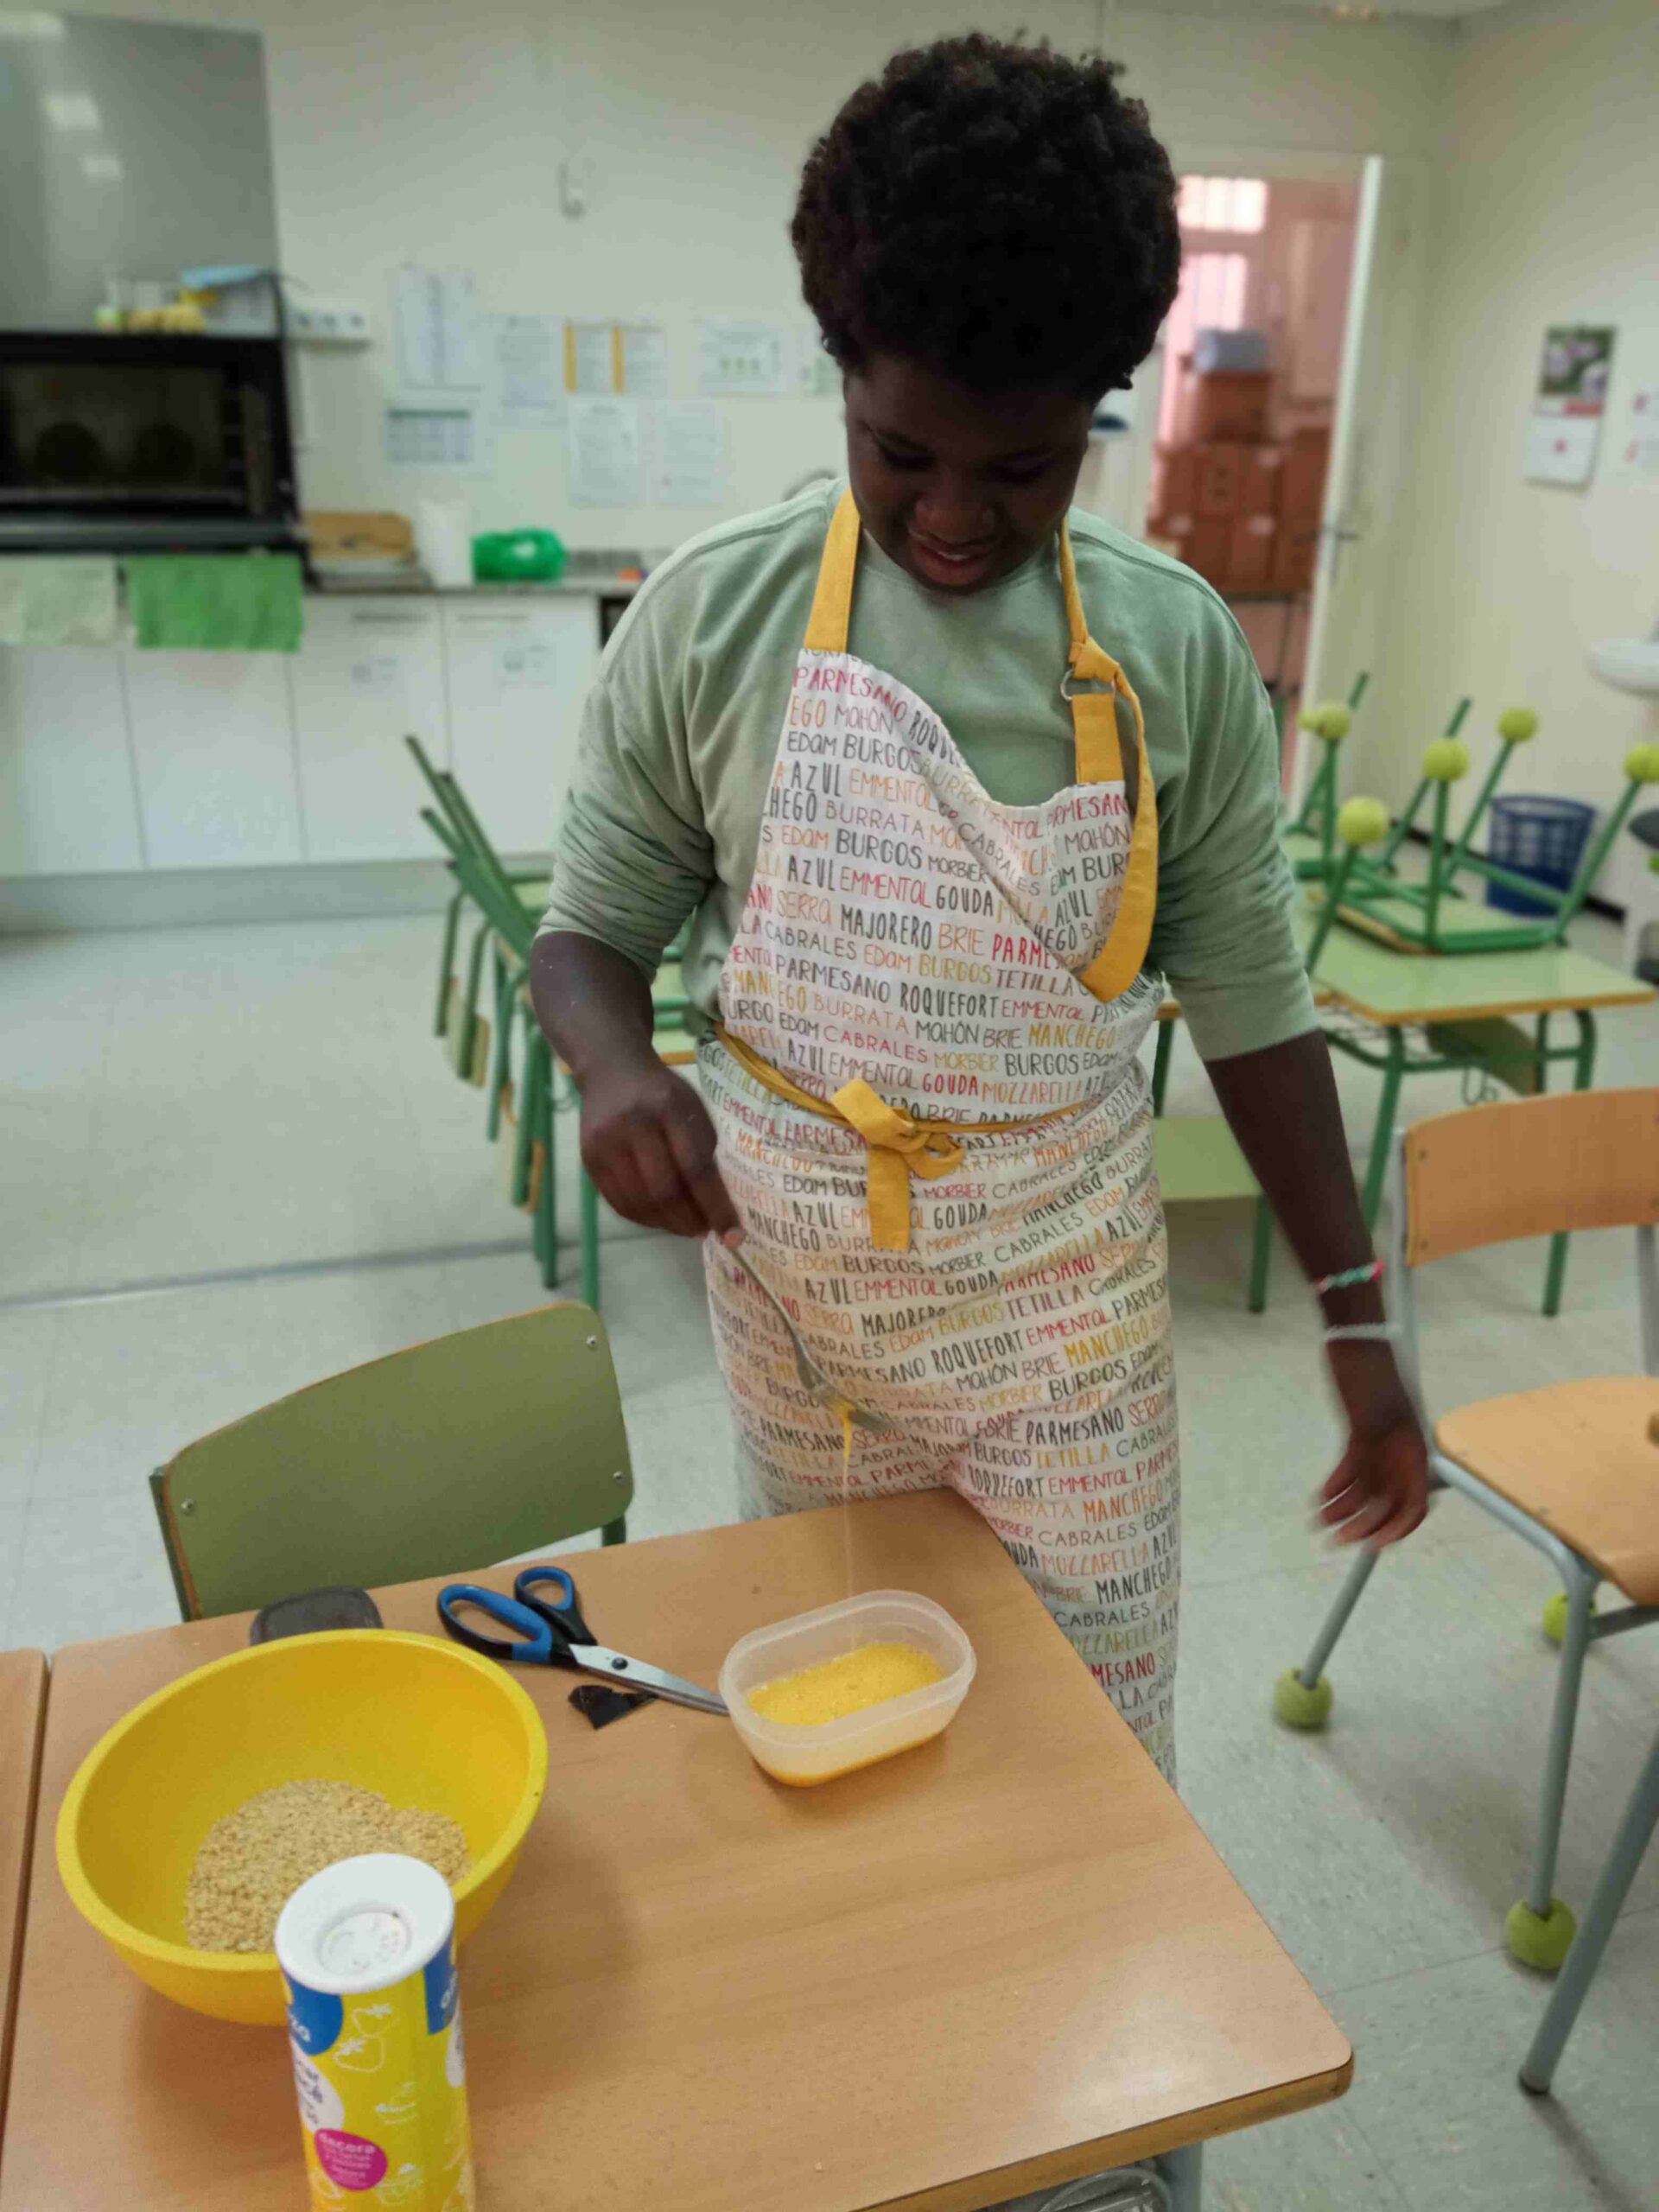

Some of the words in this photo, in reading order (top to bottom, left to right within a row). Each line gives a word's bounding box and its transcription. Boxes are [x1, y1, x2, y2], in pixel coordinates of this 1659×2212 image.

[791, 696, 827, 728] EGO
[793, 667, 907, 722] PARMESANO
[787, 733, 837, 756] EDAM
[843, 734, 921, 776] BURGOS
[790, 760, 841, 798] AZUL
[825, 800, 925, 840] BURRATA
[781, 825, 830, 850] EDAM
[836, 829, 922, 870] BURGOS
[787, 855, 836, 891] AZUL
[840, 866, 931, 909] EMMENTAL
[936, 884, 993, 917] GOUDA
[841, 904, 931, 950] MAJORERO
[938, 922, 985, 956] BRIE
[765, 920, 857, 961] CABRALES
[864, 944, 911, 973] EDAM
[918, 953, 991, 984] BURGOS
[996, 969, 1073, 997] TETILLA
[777, 954, 891, 1003] PARMESANO
[899, 982, 999, 1020] ROQUEFORT
[814, 993, 910, 1035] BURRATA
[983, 1027, 1024, 1050] BRIE
[1028, 1022, 1116, 1050] MANCHEGO
[779, 1012, 819, 1037] EDAM
[824, 1025, 927, 1064] CABRALES
[1005, 1052, 1078, 1077] BURGOS
[788, 1039, 827, 1076] AZUL
[923, 1073, 978, 1096] GOUDA
[783, 1174, 827, 1193] EDAM
[747, 1205, 820, 1252] MANCHEGO
[793, 1200, 840, 1230] AZUL
[934, 1202, 988, 1230] GOUDA
[842, 1255, 925, 1274] BURGOS
[995, 1212, 1084, 1262] CABRALES
[805, 1277, 851, 1305] AZUL
[945, 1270, 998, 1296] GOUDA
[938, 1300, 1005, 1335] BURGOS
[1007, 1285, 1084, 1319] TETILLA
[931, 1329, 1024, 1376] ROQUEFORT
[1027, 1308, 1109, 1346] EMMENTAL
[1022, 1352, 1065, 1381] BRIE
[1064, 1316, 1149, 1367] MANCHEGO
[1048, 1359, 1128, 1402] BURGOS
[1027, 1407, 1124, 1446] PARMESANO
[975, 1444, 1032, 1466] BURGOS
[1048, 1469, 1132, 1495] EMMENTAL
[1083, 1484, 1165, 1524] MANCHEGO
[1039, 1522, 1138, 1547] CABRALES
[1096, 1556, 1172, 1604] MANCHEGO
[1053, 1601, 1151, 1628] CABRALES
